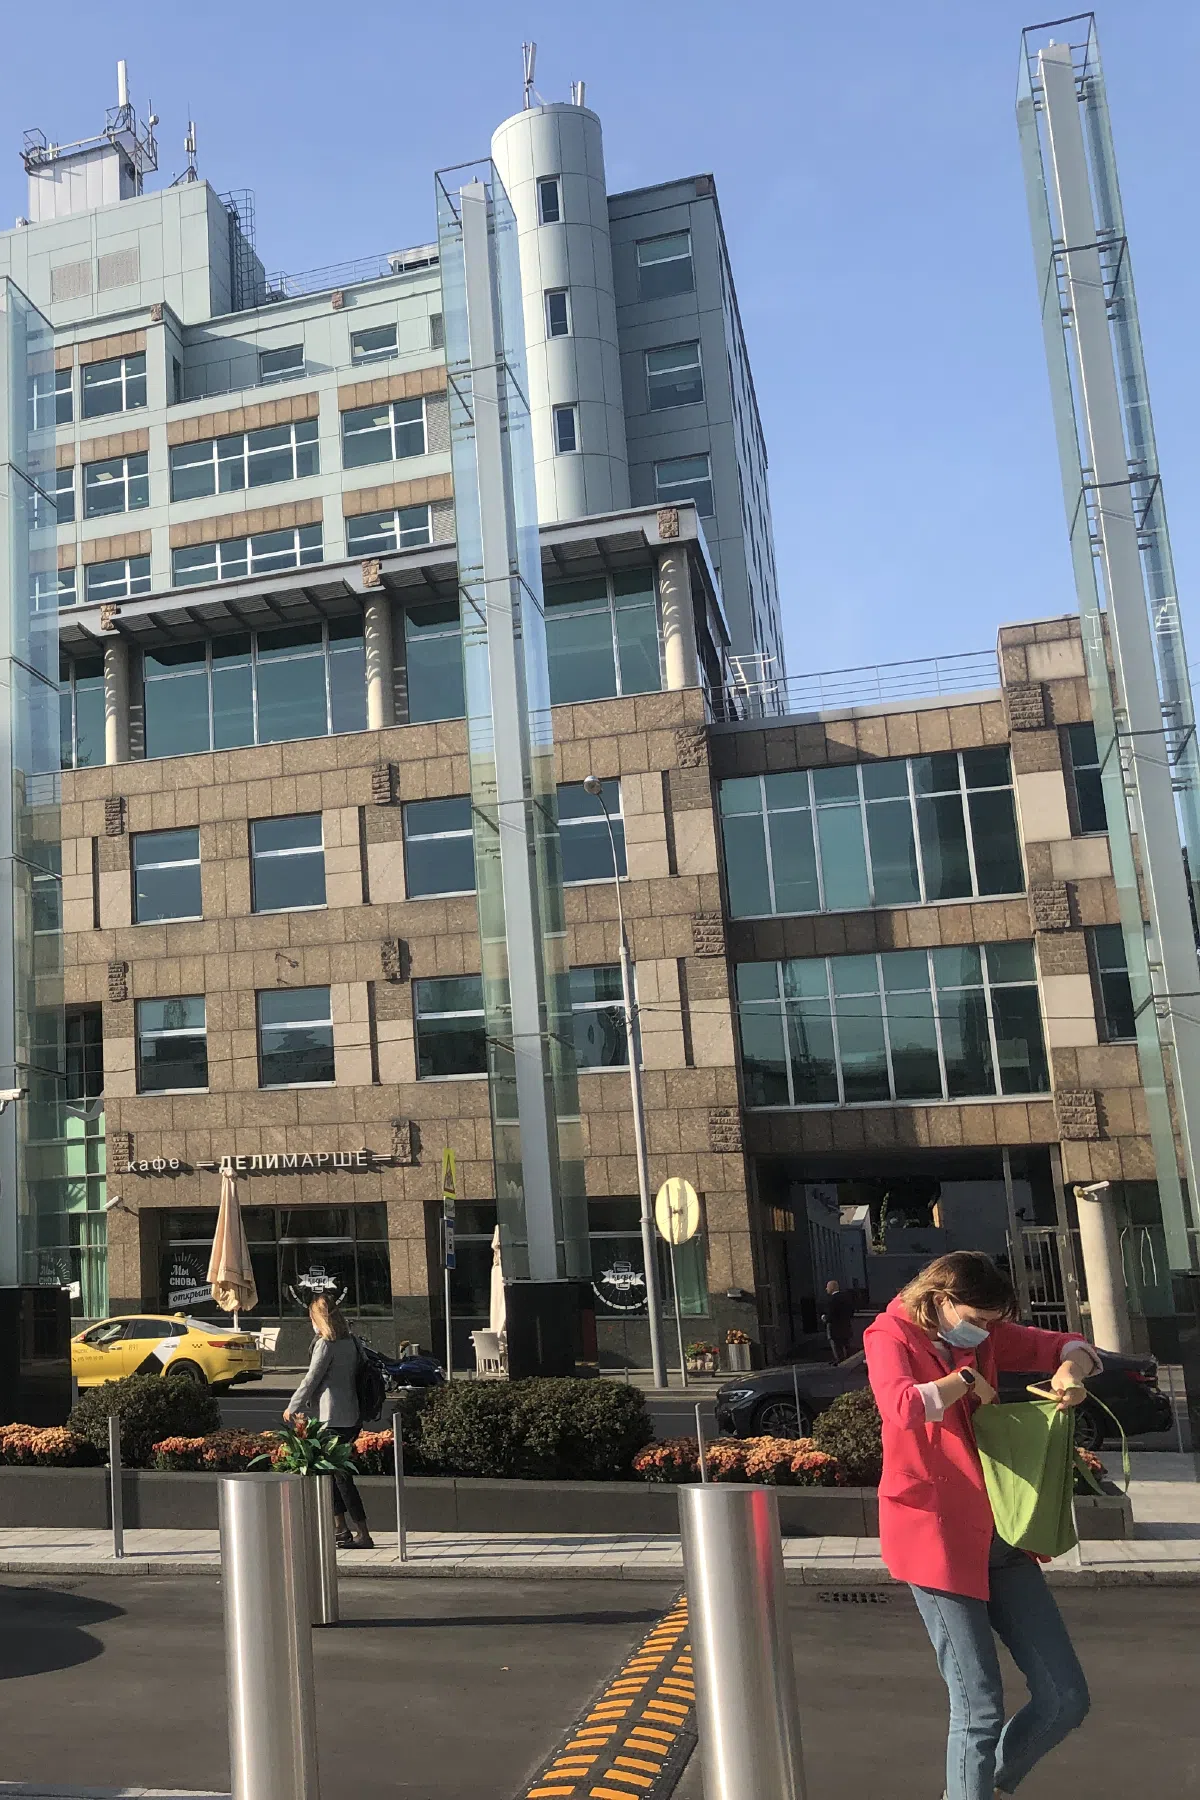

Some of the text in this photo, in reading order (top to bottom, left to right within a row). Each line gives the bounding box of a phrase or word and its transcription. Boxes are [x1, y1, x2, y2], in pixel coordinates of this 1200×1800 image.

[127, 1150, 368, 1173] кафе ДЕЛИМАРШЕ
[170, 1264, 189, 1276] Мы
[169, 1277, 197, 1287] СНОВА
